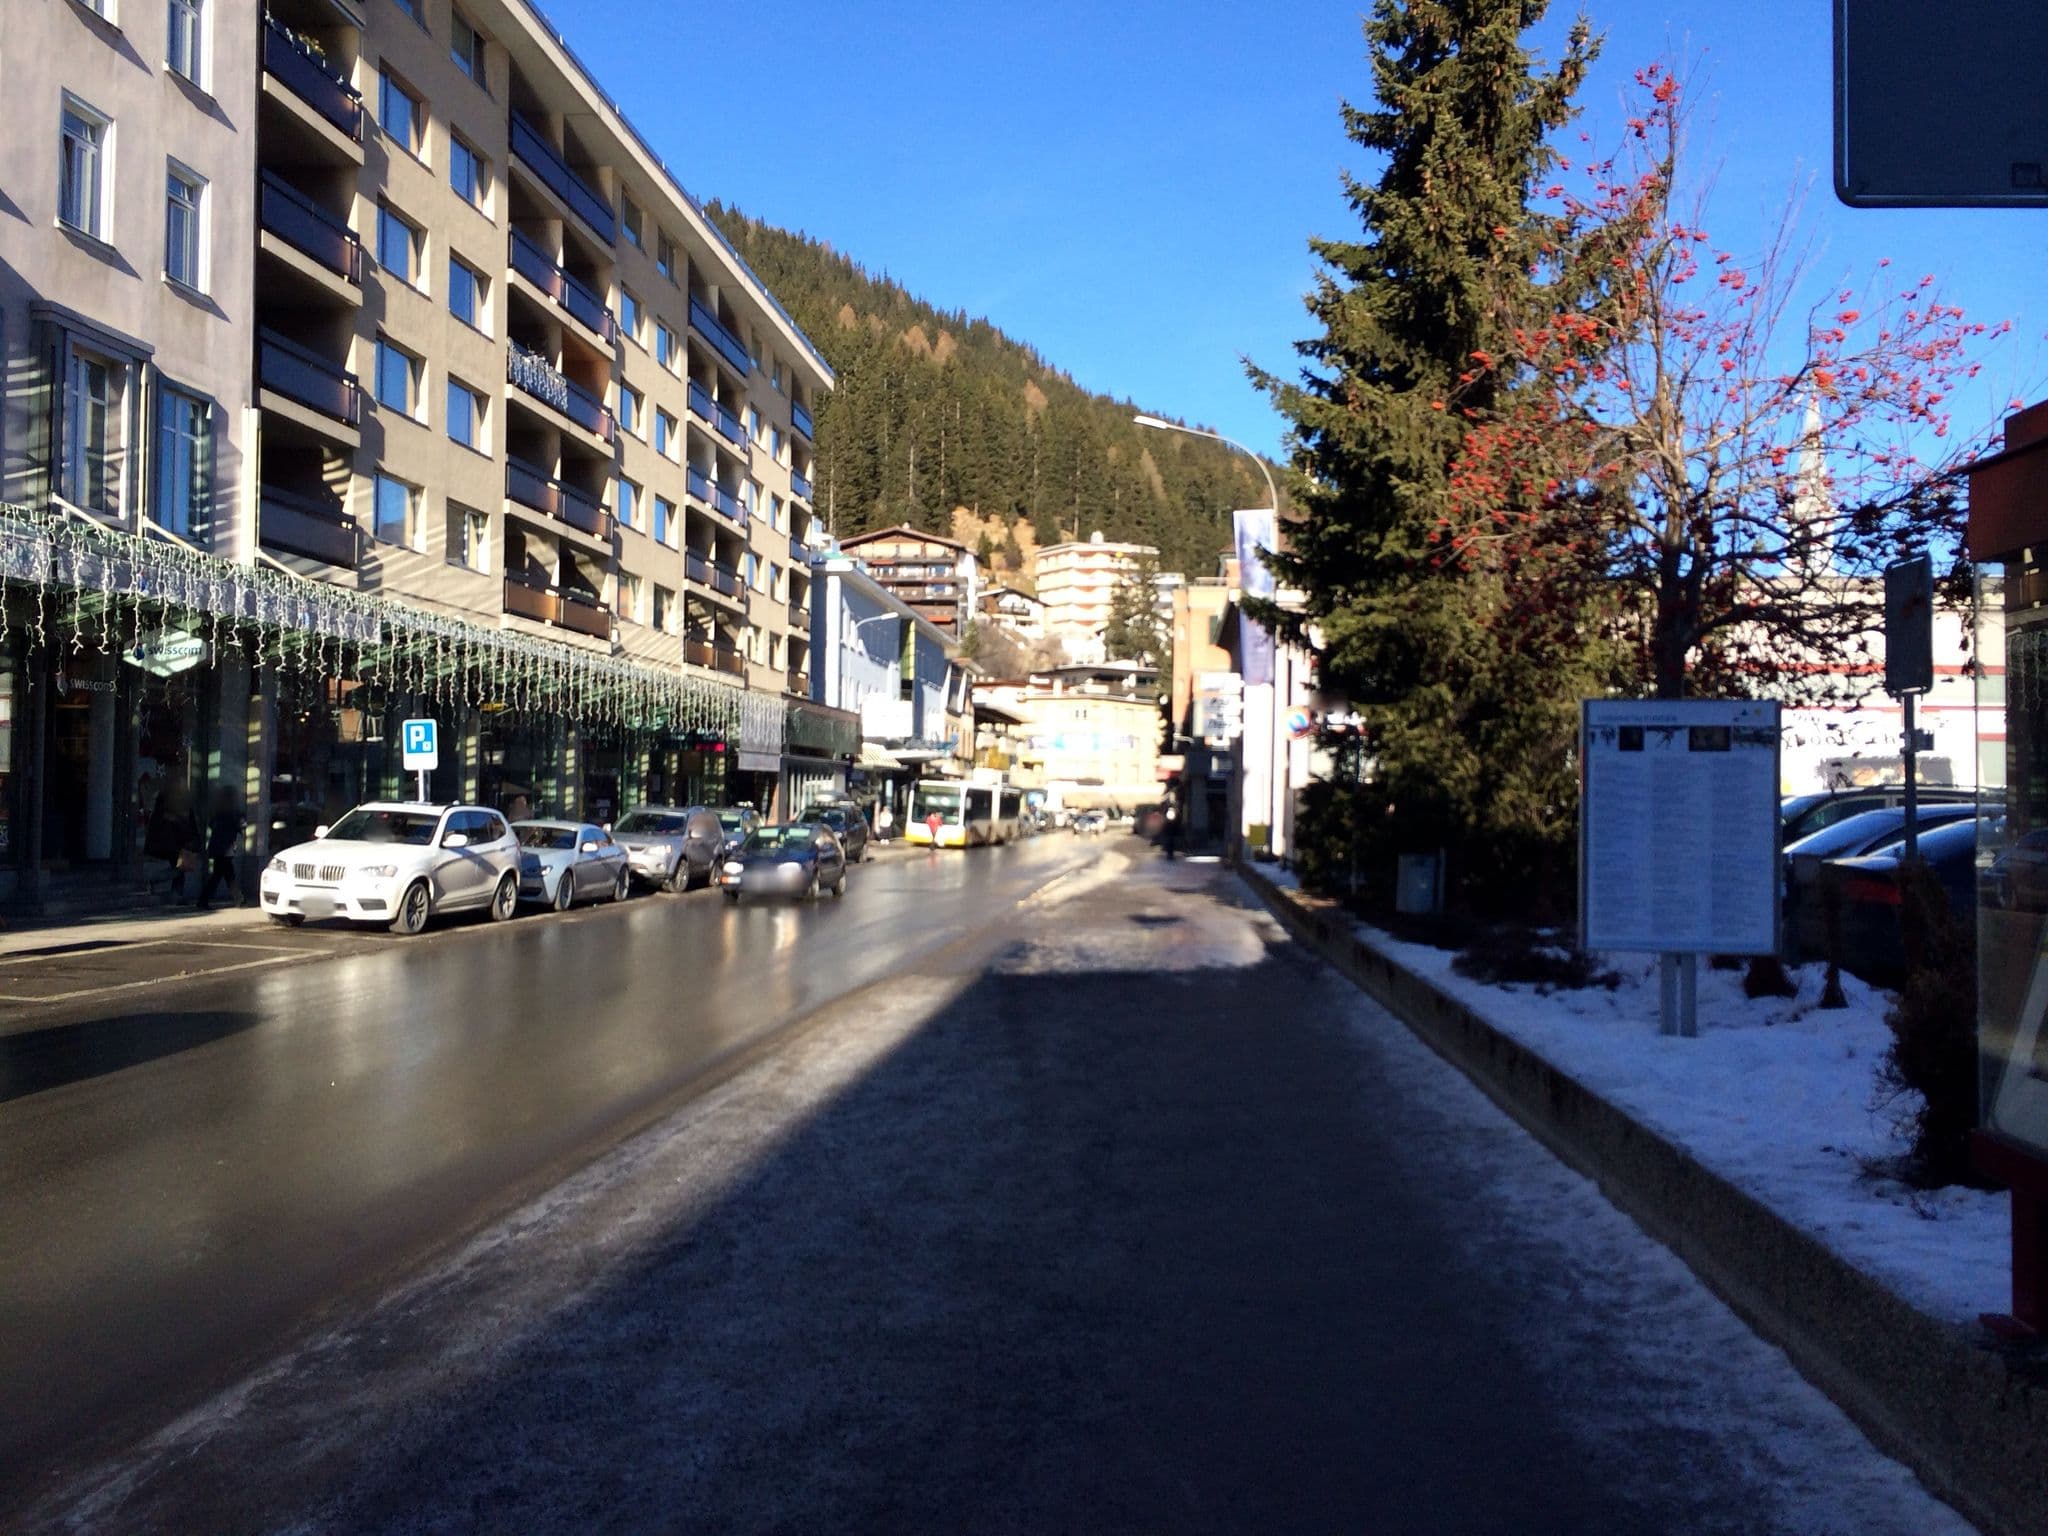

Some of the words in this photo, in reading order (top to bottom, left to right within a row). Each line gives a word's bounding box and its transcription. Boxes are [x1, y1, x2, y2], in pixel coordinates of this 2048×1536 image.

[148, 645, 202, 656] swisscom
[70, 679, 114, 692] swisscom
[410, 725, 425, 750] P
